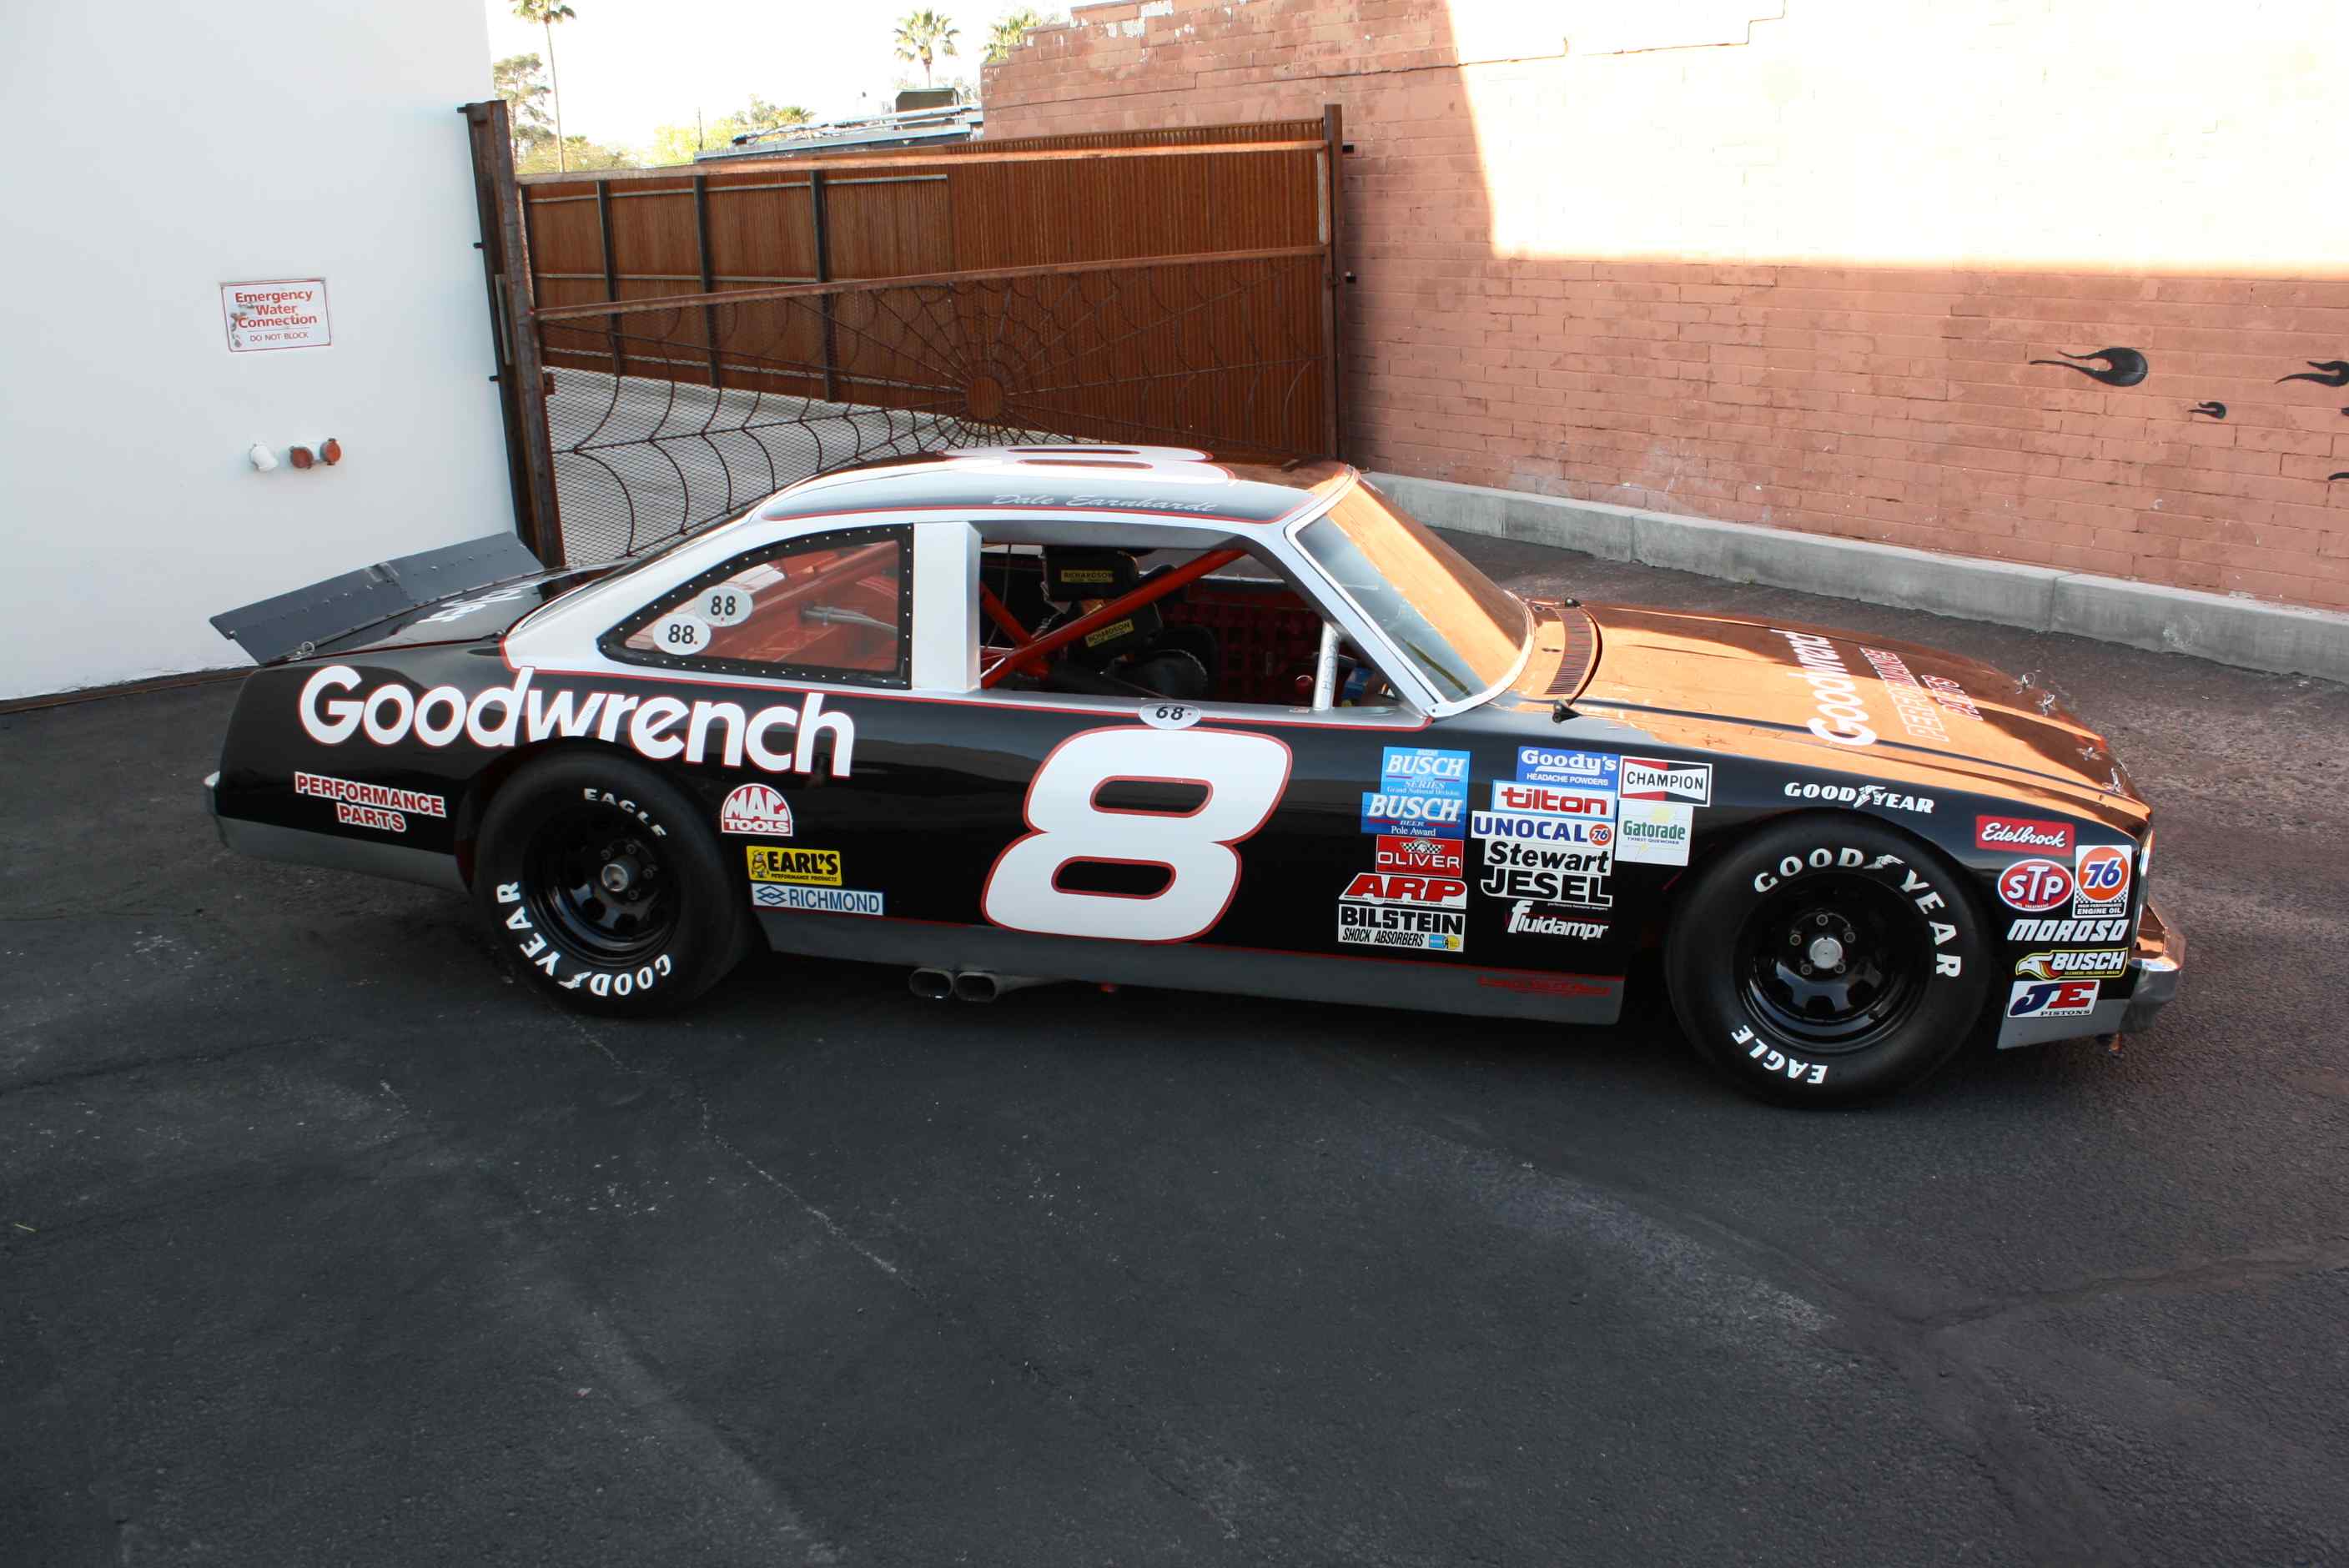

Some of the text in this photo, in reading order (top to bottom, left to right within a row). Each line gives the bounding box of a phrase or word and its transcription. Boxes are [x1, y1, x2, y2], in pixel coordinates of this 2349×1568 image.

[235, 291, 314, 304] Emergency
[254, 304, 298, 315] Water
[238, 314, 318, 329] Connection
[992, 494, 1219, 512] Dale Earnhardt
[711, 596, 736, 616] 88
[299, 665, 854, 777] Goodwrench
[1386, 755, 1466, 776] BUSCH
[1521, 749, 1617, 776] Goody's
[1527, 773, 1608, 787] HEADACHE POWDERS
[1627, 771, 1704, 790] CHAMPION
[295, 771, 446, 817] PERFORMANCE
[724, 787, 789, 822] MAC
[1501, 787, 1607, 815] tilton
[1783, 781, 1935, 814] GOODYEAR
[336, 802, 406, 832] PARTS
[584, 787, 666, 836] EAGLE
[1367, 794, 1463, 822] BUSCH
[726, 818, 789, 833] TOOLS
[980, 725, 1293, 945] 8
[1391, 826, 1436, 837] Pole Award
[1473, 816, 1609, 842] UNOCAL 76
[1622, 819, 1687, 840] Gatorade
[1981, 822, 2067, 848] Edelbrock
[767, 851, 838, 875] EARL'S
[1377, 852, 1460, 869] OLIVER
[1487, 840, 1610, 874] Stewart
[1481, 867, 1612, 905] JESEL
[2006, 866, 2065, 902] STP
[2082, 857, 2123, 889] 76
[789, 888, 880, 913] RICHMOND
[1346, 873, 1466, 902] ARP
[1340, 906, 1462, 936] BILSTEIN
[1507, 900, 1609, 941] fluidampr
[1754, 847, 1961, 977] GOODYEAR
[495, 881, 672, 996] GOODYEAR
[1342, 927, 1425, 947] SHOCK ABSORBERS
[2007, 919, 2130, 942] MOROSO
[2051, 951, 2125, 971] BUSCH
[2009, 981, 2097, 1016] JE
[1731, 1024, 1828, 1084] EAGLE
